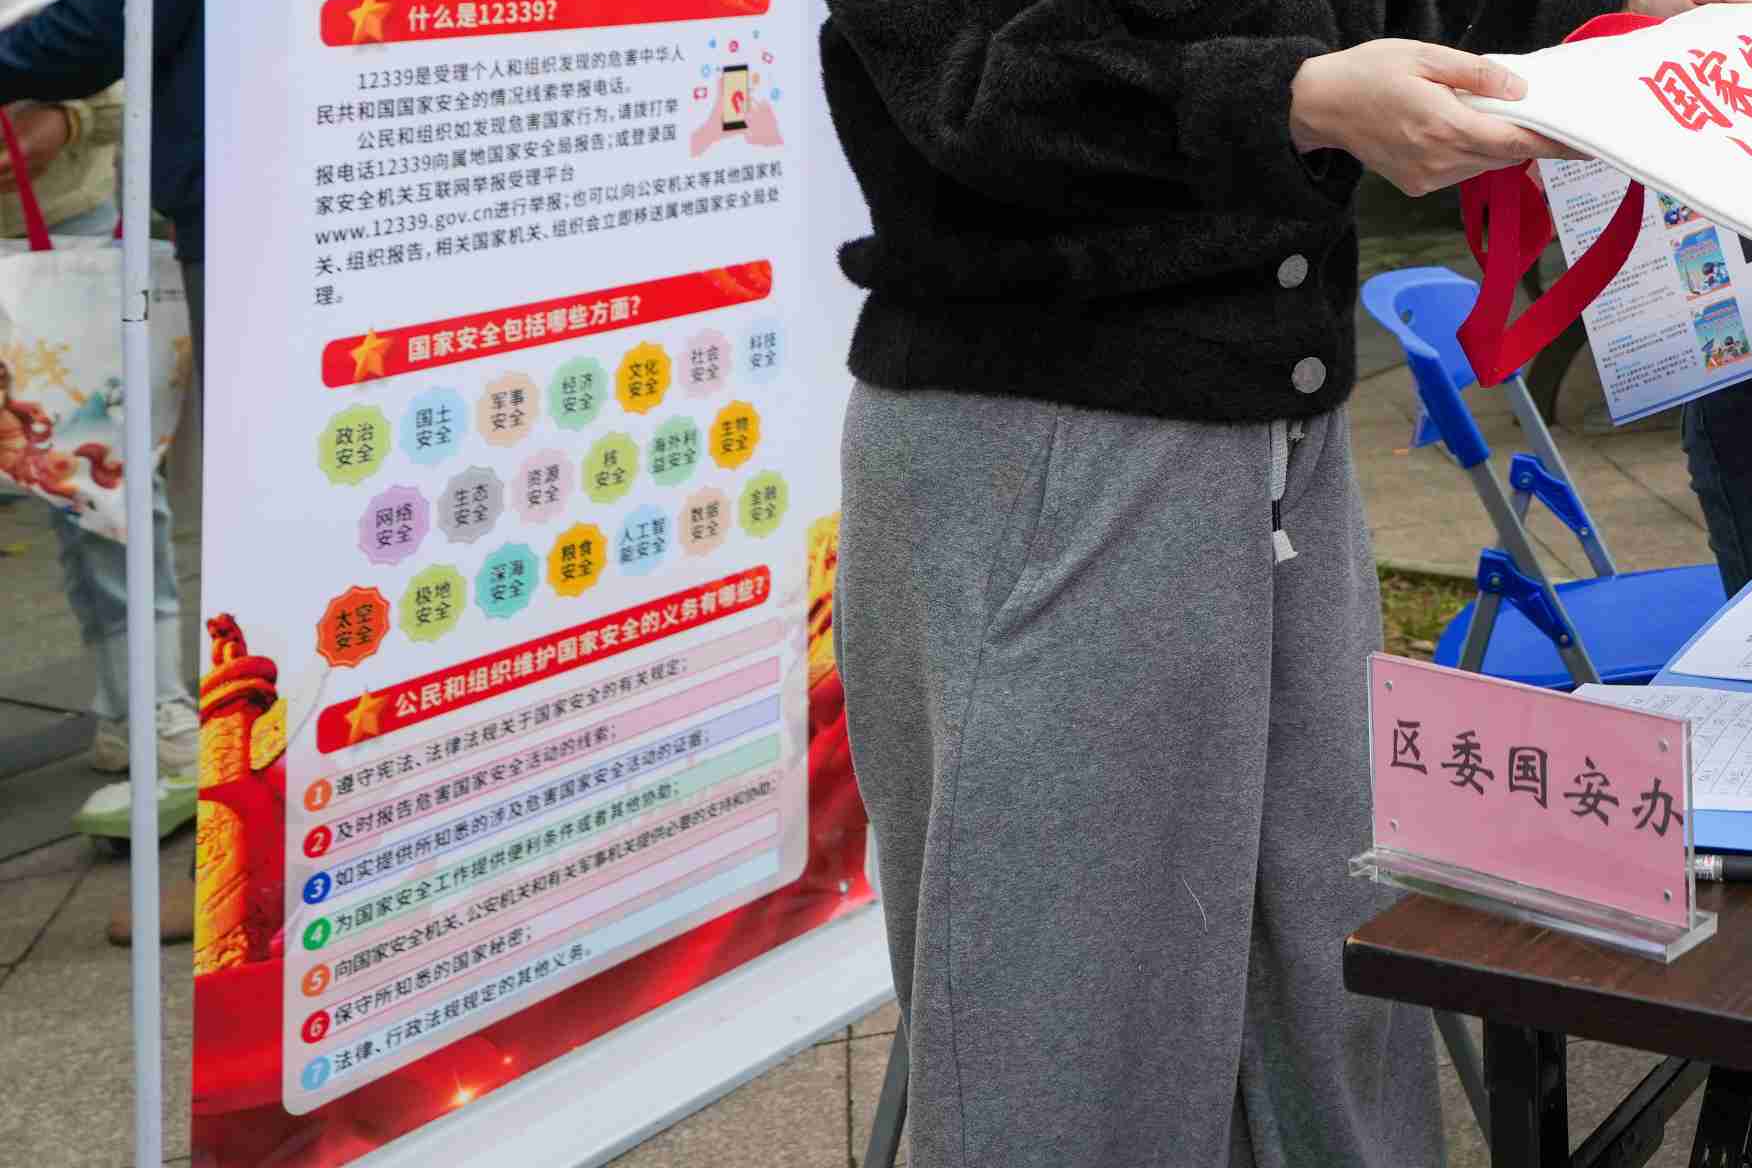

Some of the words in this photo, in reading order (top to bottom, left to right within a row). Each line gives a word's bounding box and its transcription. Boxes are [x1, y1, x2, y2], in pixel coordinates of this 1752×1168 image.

[408, 0, 558, 37] 什么是12339？
[358, 44, 685, 91] 12339是受理个人和组织发现的危害中华人
[315, 167, 574, 216] 家安全机关互联网举报受理平台
[314, 284, 343, 306] 理。
[408, 295, 641, 363] 国家安全包括哪些方面？
[629, 360, 658, 379] 文化
[562, 373, 593, 394] 经济
[629, 379, 658, 398] 安全
[563, 393, 593, 414] 安全
[416, 404, 452, 428] 国土
[492, 407, 526, 431] 安全
[336, 423, 374, 446] 政治
[416, 425, 452, 449] 安全
[336, 444, 374, 468] 安全
[455, 506, 489, 528] 安全
[376, 527, 412, 548] 安全
[416, 582, 451, 603] 极地
[336, 604, 374, 630] 太空
[416, 601, 452, 627] 安全
[336, 625, 374, 650] 安全
[395, 575, 767, 716] 公民和组织维护国家安全的义务有哪些？
[1390, 720, 1684, 837] 区委国安办
